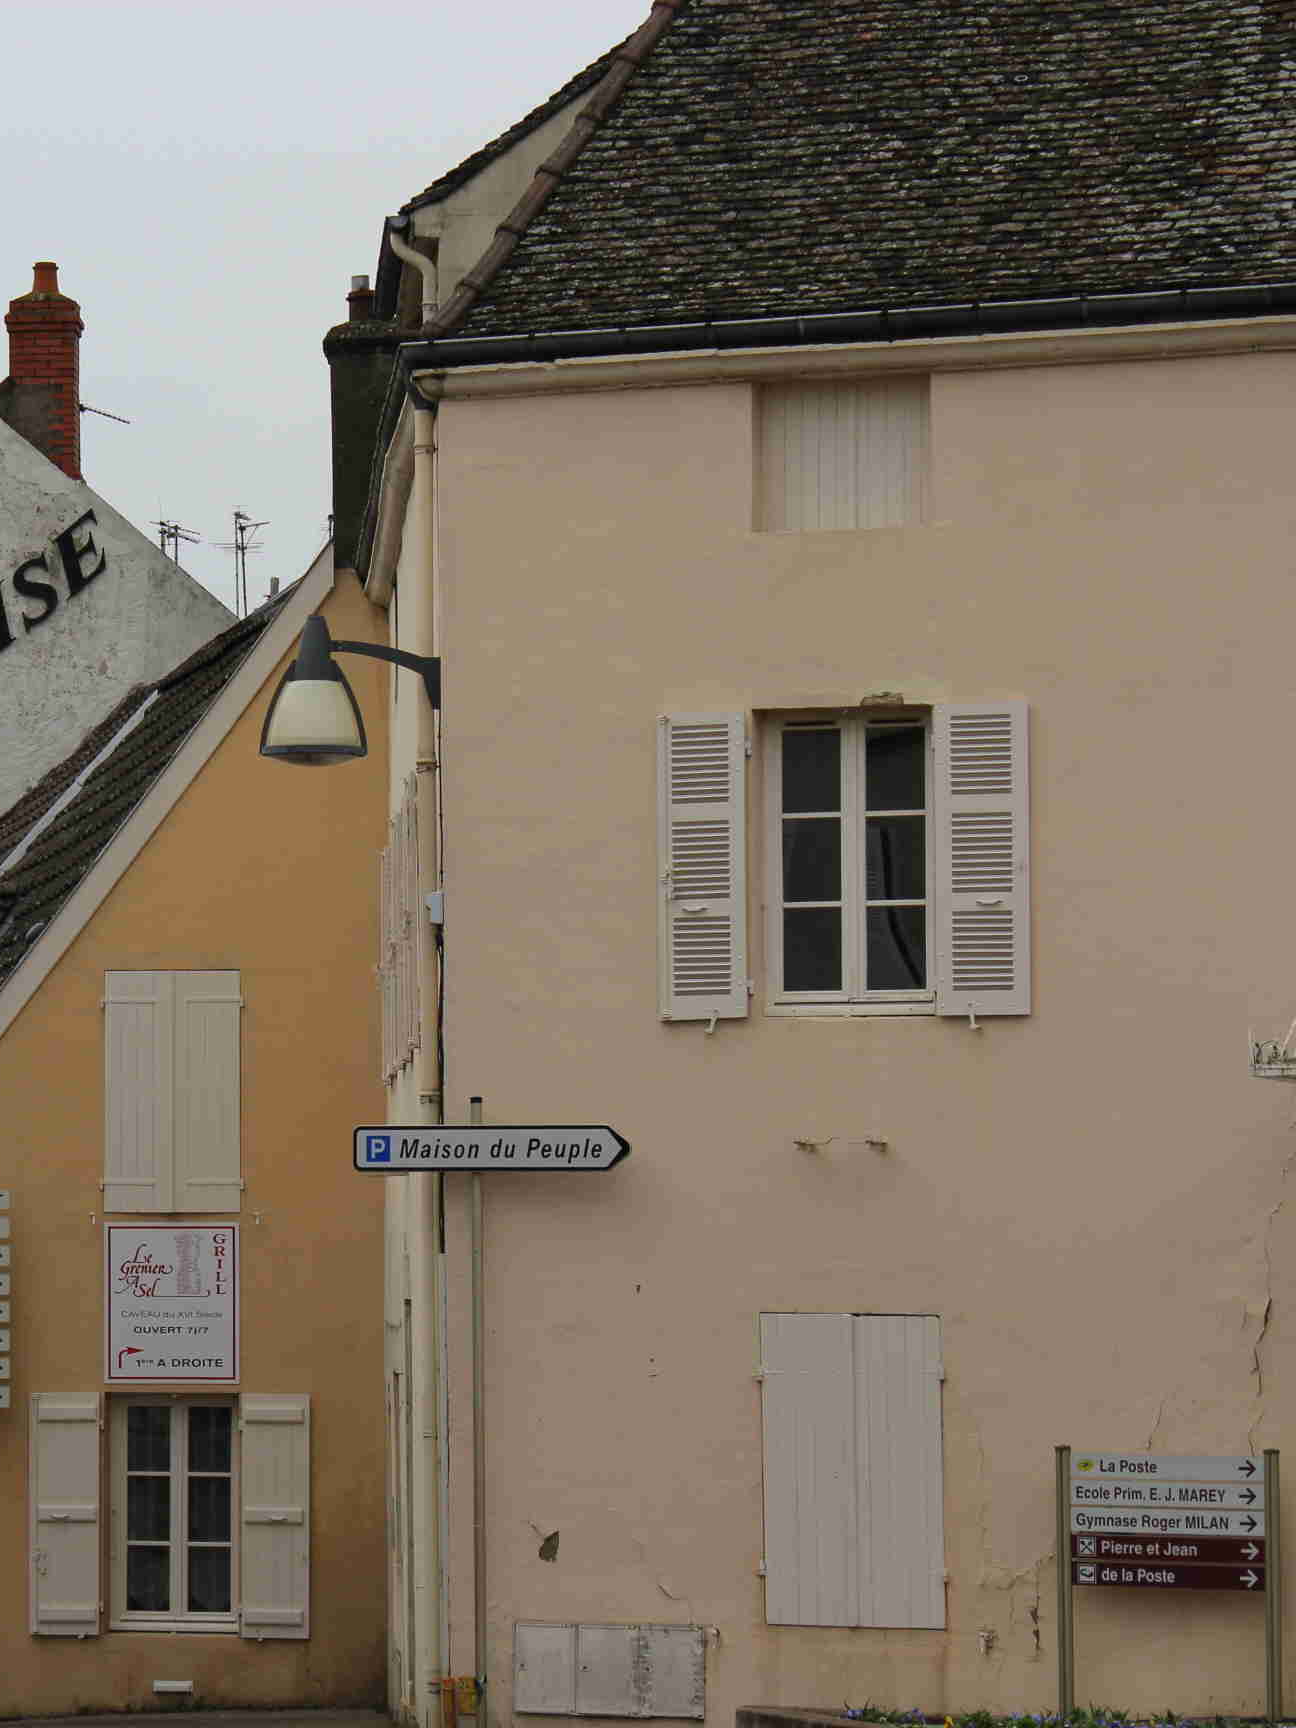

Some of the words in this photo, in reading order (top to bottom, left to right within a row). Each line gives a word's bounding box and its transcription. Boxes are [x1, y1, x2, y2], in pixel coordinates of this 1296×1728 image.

[399, 1138, 480, 1159] Maison
[490, 1138, 516, 1159] du
[526, 1138, 603, 1164] Peuple
[133, 1243, 153, 1264] Le
[117, 1261, 174, 1280] Grenier
[212, 1233, 227, 1295] GRILL
[134, 1326, 183, 1334] OUVERT
[157, 1359, 166, 1367] A
[171, 1358, 224, 1367] DROITE
[1099, 1459, 1115, 1472] La
[1120, 1460, 1157, 1473] Poste
[1076, 1486, 1110, 1500] Ecole
[1114, 1486, 1146, 1501] Prim.
[1150, 1488, 1162, 1501] E.
[1165, 1488, 1176, 1501] J.
[1179, 1488, 1226, 1502] MAREY
[1076, 1513, 1137, 1529] Gymnase
[1141, 1515, 1181, 1531] Roger
[1185, 1516, 1229, 1529] MILAN
[1101, 1541, 1143, 1554] Pierre
[1146, 1543, 1160, 1554] et
[1164, 1543, 1198, 1556] Jean
[1102, 1568, 1118, 1581] de
[1121, 1568, 1134, 1582] la
[1137, 1568, 1175, 1583] Poste
